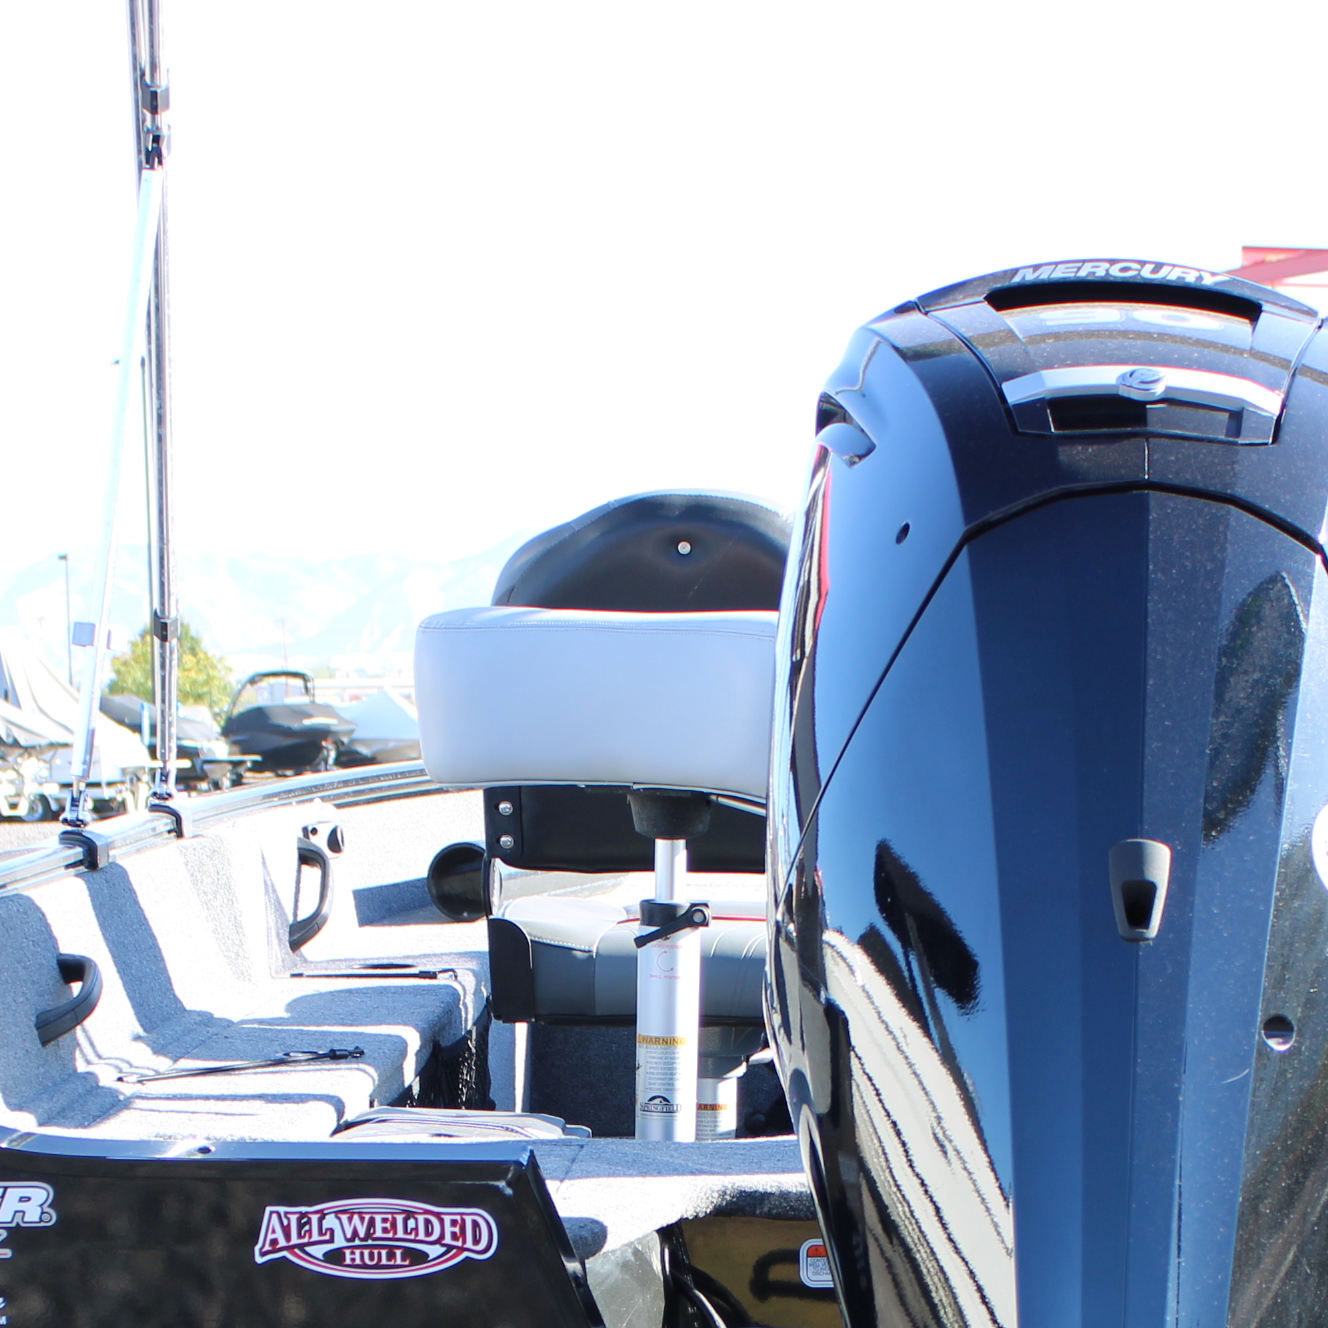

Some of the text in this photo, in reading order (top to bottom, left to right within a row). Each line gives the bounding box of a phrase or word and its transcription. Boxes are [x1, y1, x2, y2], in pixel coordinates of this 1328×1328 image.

[1012, 262, 1230, 286] MERCURY
[1039, 308, 1222, 331] 90
[642, 1037, 686, 1046] WARNING
[261, 1211, 490, 1252] ALL WELDED
[343, 1248, 410, 1266] HULL
